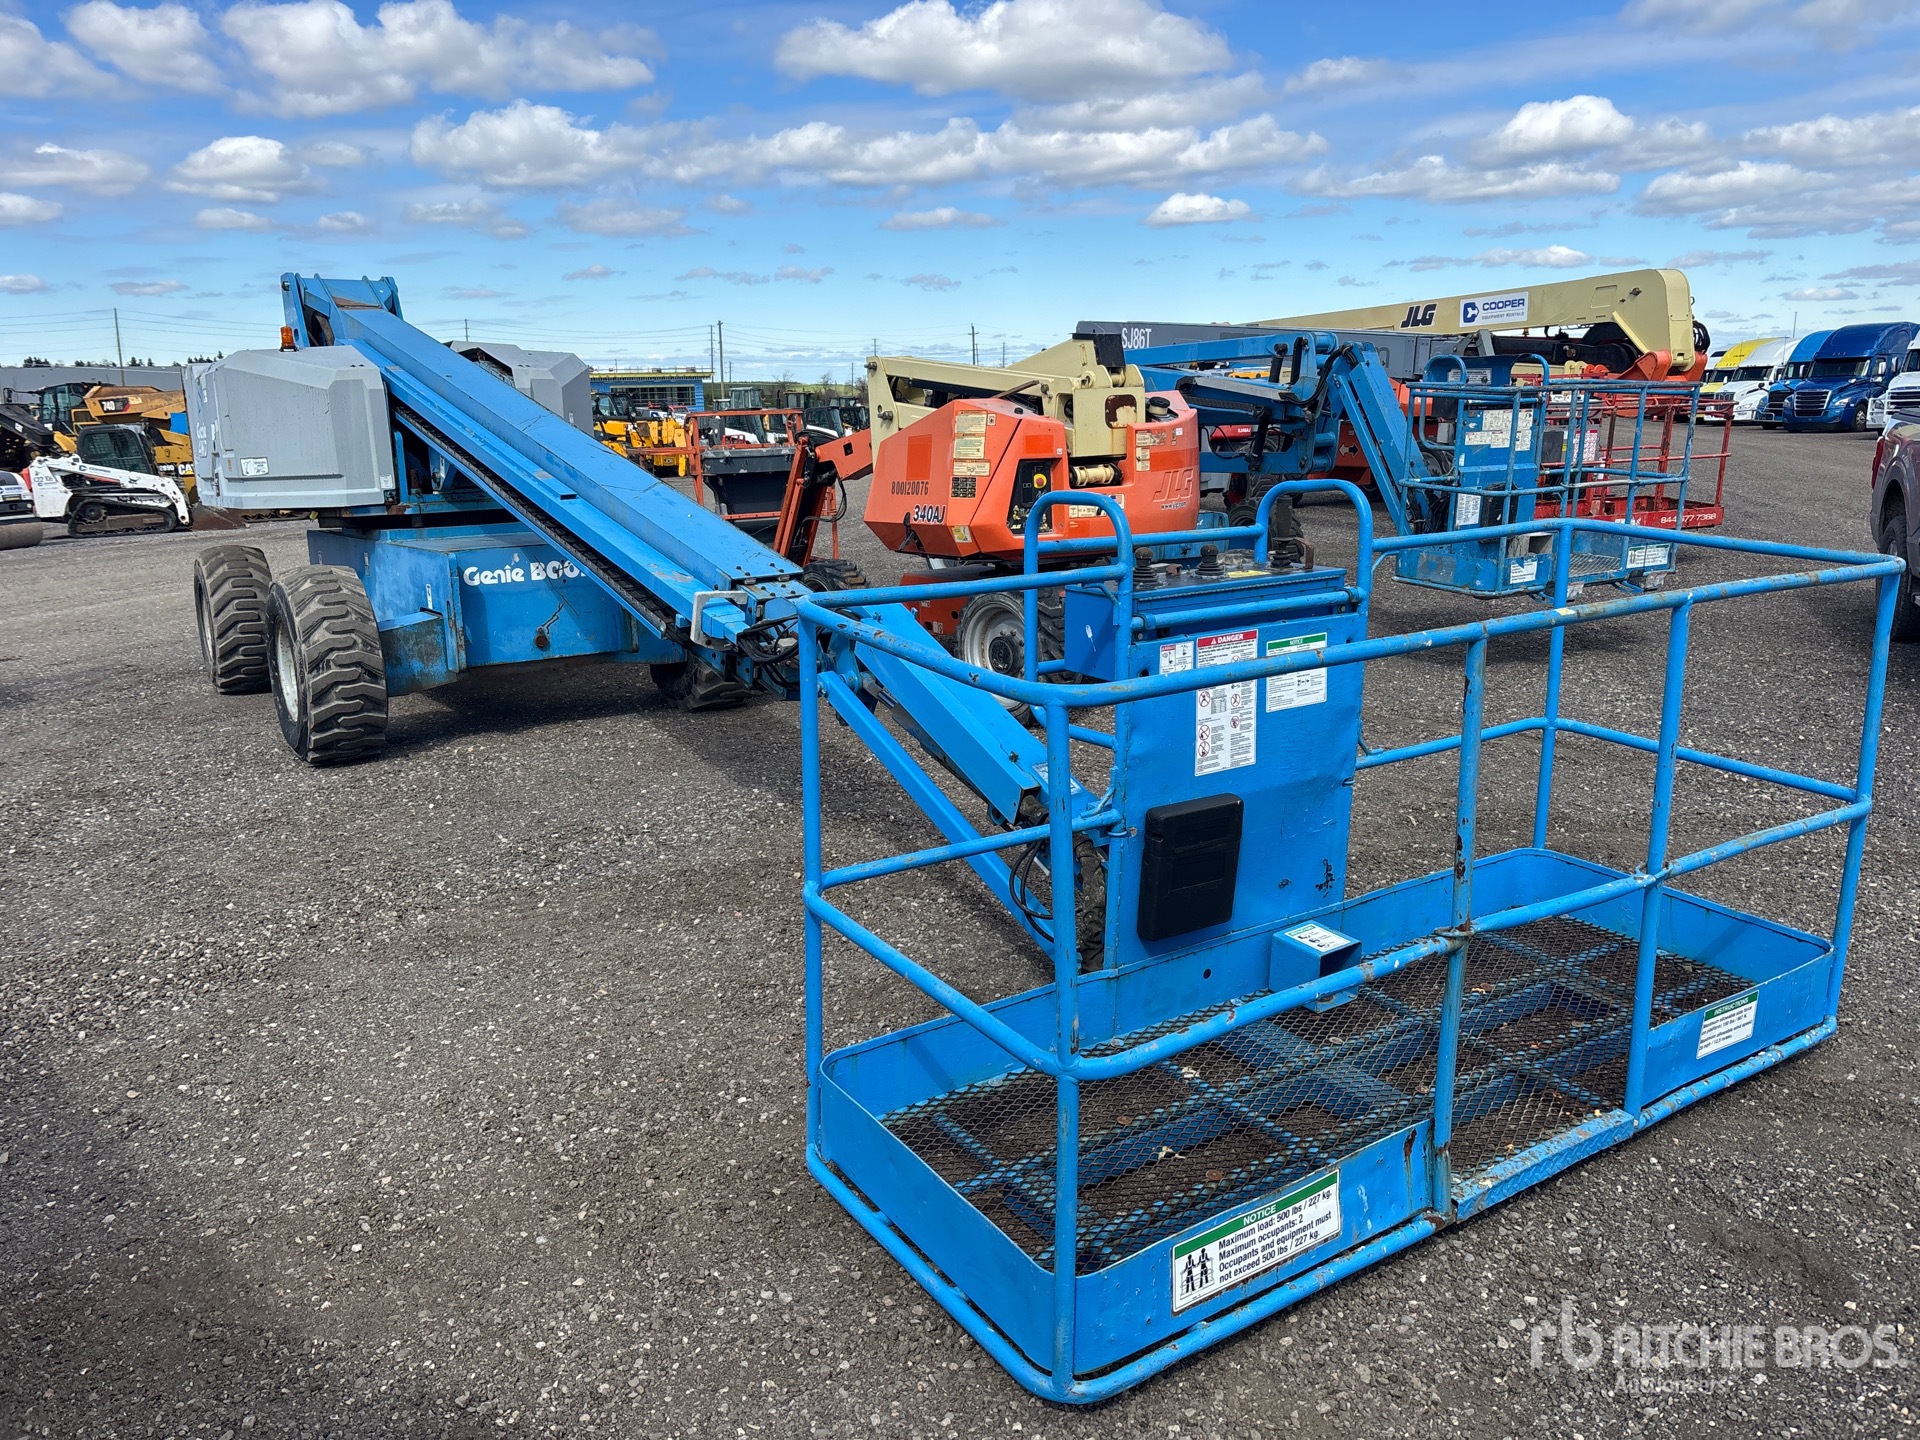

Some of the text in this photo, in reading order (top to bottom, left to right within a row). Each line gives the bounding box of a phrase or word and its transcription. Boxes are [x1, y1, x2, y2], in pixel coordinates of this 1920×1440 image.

[1400, 303, 1437, 328] JLG
[1482, 298, 1525, 311] COOPER
[1121, 327, 1152, 349] SJ86T
[101, 400, 116, 411] 740
[178, 463, 194, 475] CA
[891, 481, 929, 496] 800120076
[1153, 469, 1194, 503] JLG
[913, 504, 947, 525] 340AJ
[463, 560, 587, 587] Genie BOO
[1217, 633, 1244, 644] DANGER
[1713, 997, 1749, 1017] INSTRUCTIONS
[1218, 1228, 1256, 1251] Maximum
[1257, 1219, 1276, 1233] load:
[1276, 1210, 1291, 1224] 500
[1291, 1205, 1303, 1219] lbs
[1308, 1194, 1321, 1208] 227
[1322, 1189, 1333, 1202] kg.
[1243, 1204, 1277, 1226] NOTICE
[1218, 1214, 1304, 1261] Maximum occupants: 2
[1218, 1211, 1332, 1273] Occupants and equipment must
[1219, 1271, 1233, 1284] not
[1233, 1257, 1261, 1278] exceed
[1262, 1250, 1276, 1264] 500
[1277, 1244, 1289, 1259] lbs
[1294, 1236, 1308, 1249] 227
[1308, 1230, 1321, 1244] kg.
